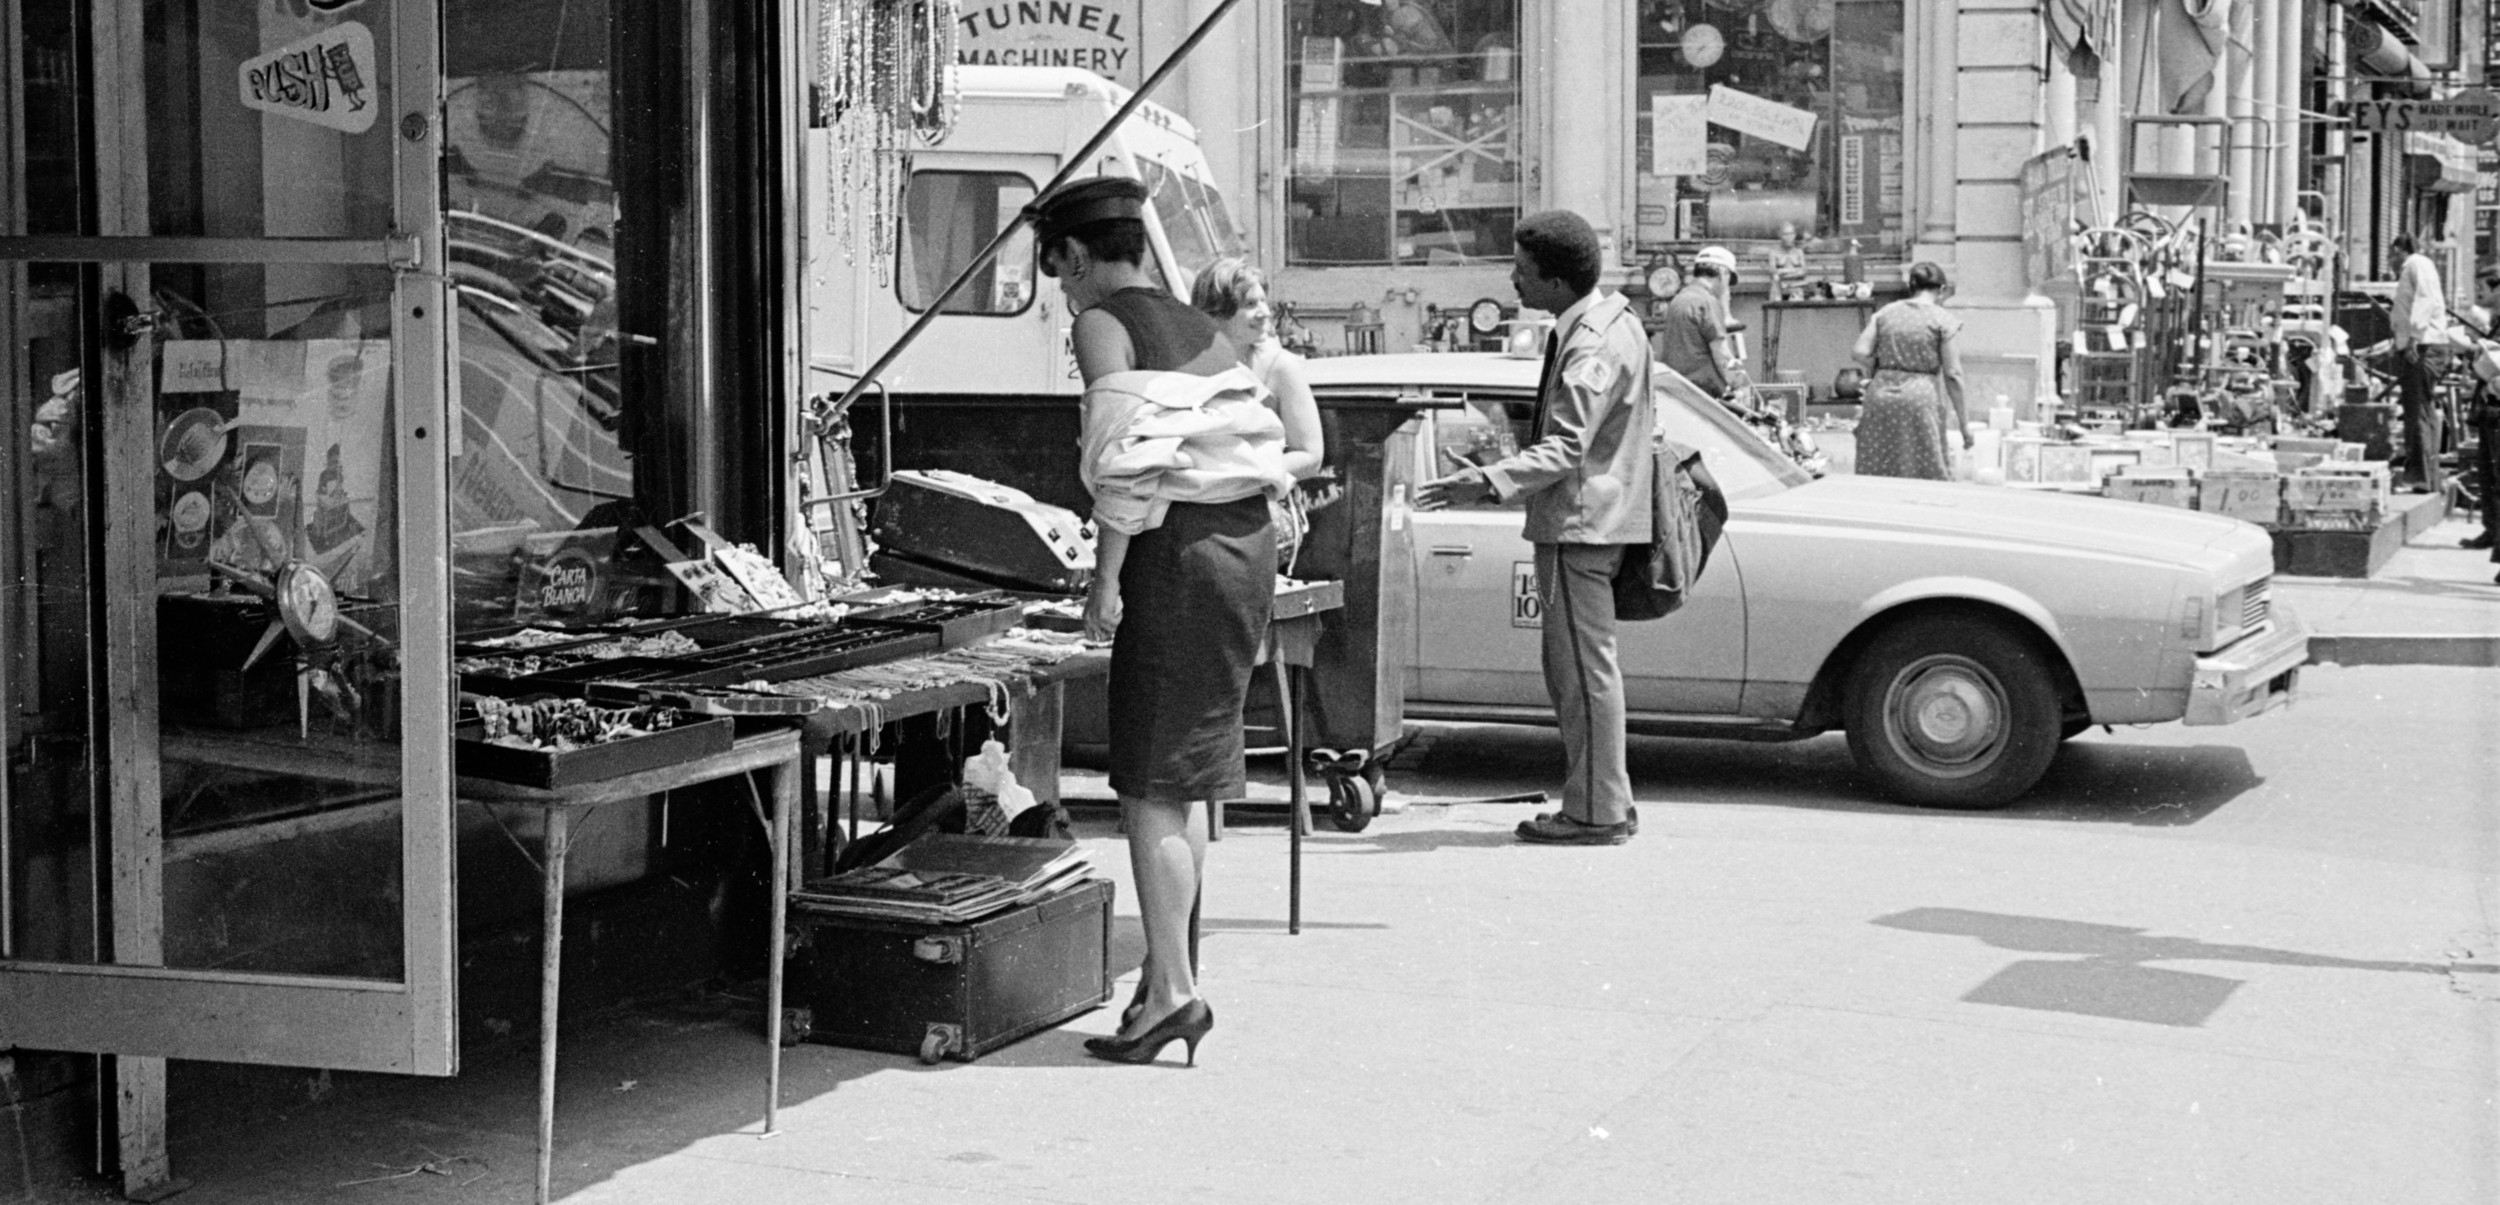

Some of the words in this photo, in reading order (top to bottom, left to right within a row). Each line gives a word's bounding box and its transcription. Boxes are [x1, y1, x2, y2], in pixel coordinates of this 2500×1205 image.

[959, 0, 1125, 42] TUNNEL
[959, 48, 1128, 70] MACHINERY
[247, 43, 329, 112] PUSH
[2336, 101, 2413, 131] KEYS
[2419, 104, 2450, 116] MADE
[2454, 104, 2489, 117] WHILE
[2447, 119, 2478, 131] WAIT
[1845, 139, 1859, 221] AMERICAN
[551, 563, 586, 586] CARTA
[542, 585, 586, 607] BLANCA
